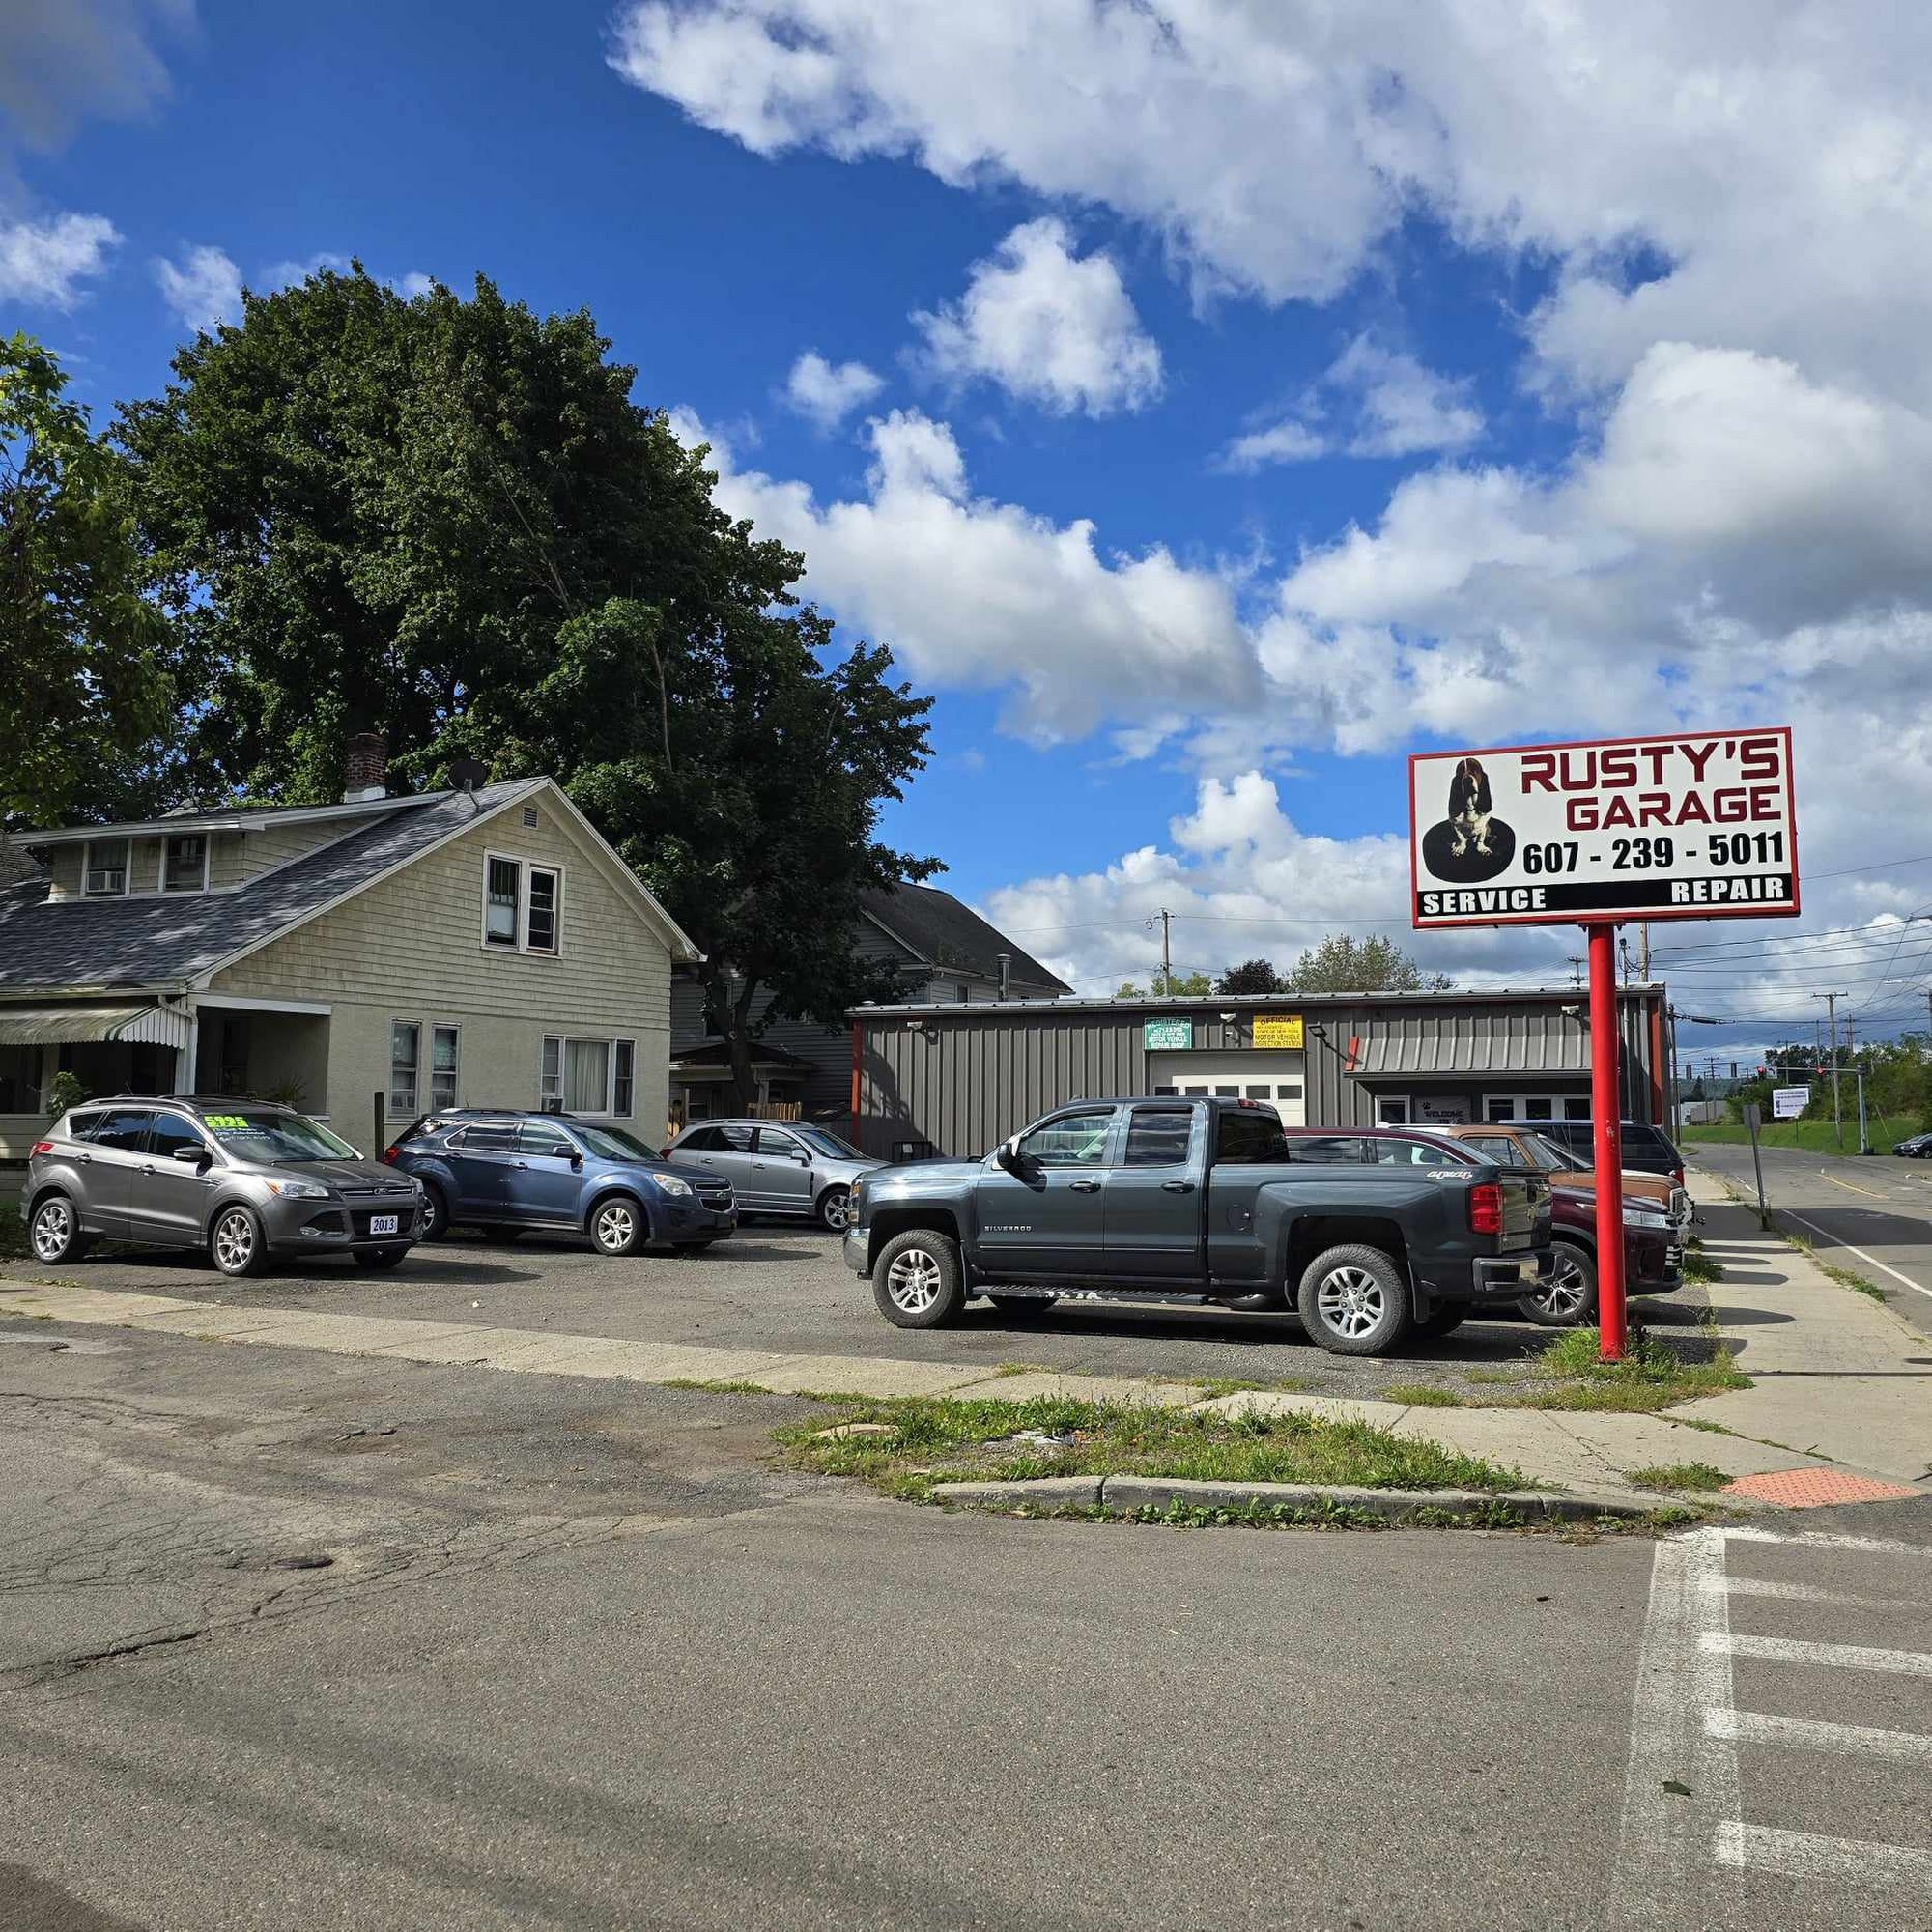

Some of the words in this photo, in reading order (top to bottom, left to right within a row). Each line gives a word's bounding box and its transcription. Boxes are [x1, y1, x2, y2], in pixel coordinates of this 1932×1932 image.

[1521, 737, 1779, 794] RUSTY'S
[1566, 784, 1781, 832] GARAGE
[1522, 841, 1579, 874] 607
[1612, 837, 1674, 870] 239
[1709, 830, 1784, 866] 5011
[1423, 887, 1547, 914] SERVICE
[1671, 876, 1785, 903] REPAIR
[1260, 1016, 1296, 1025] OFFICIAL
[373, 1217, 395, 1232] 2013
